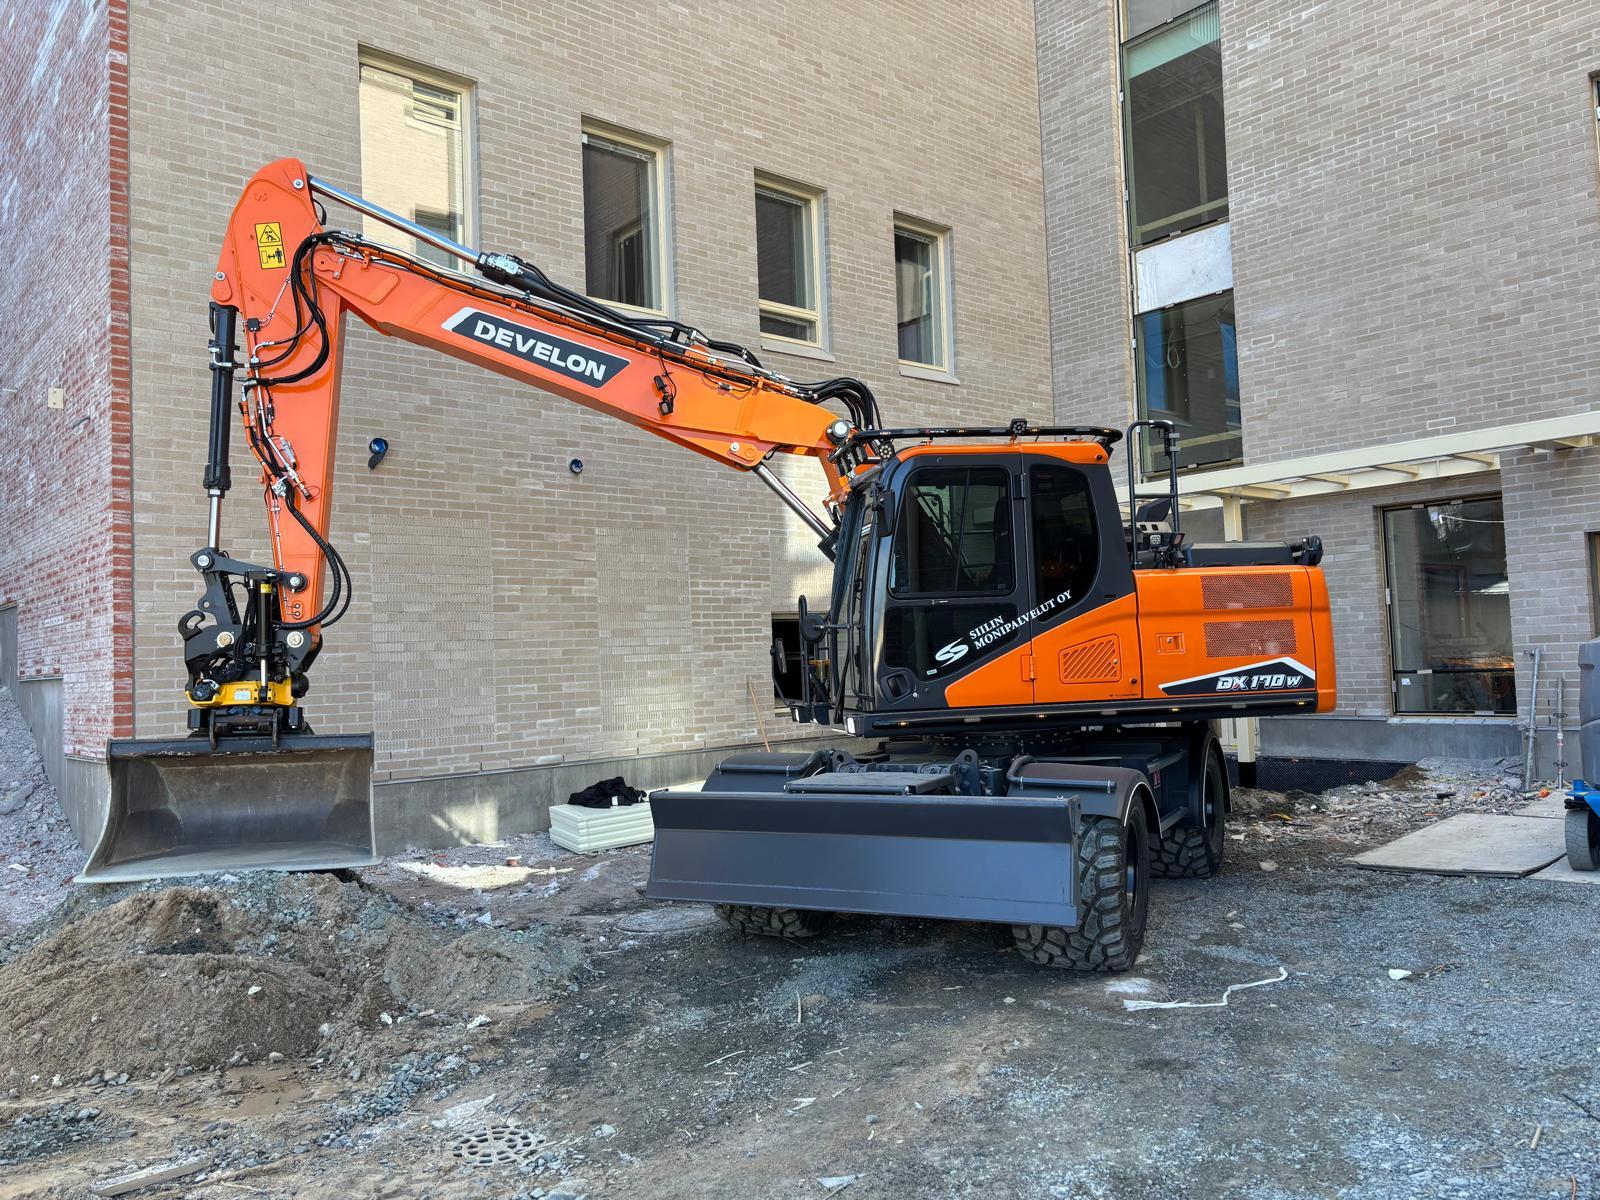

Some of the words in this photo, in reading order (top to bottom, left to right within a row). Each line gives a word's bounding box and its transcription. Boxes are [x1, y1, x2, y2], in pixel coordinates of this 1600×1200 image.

[473, 319, 607, 381] DEVELON
[969, 615, 1004, 640] SIILIN
[974, 598, 1055, 650] MONIPALVELUT
[1056, 590, 1072, 604] OY
